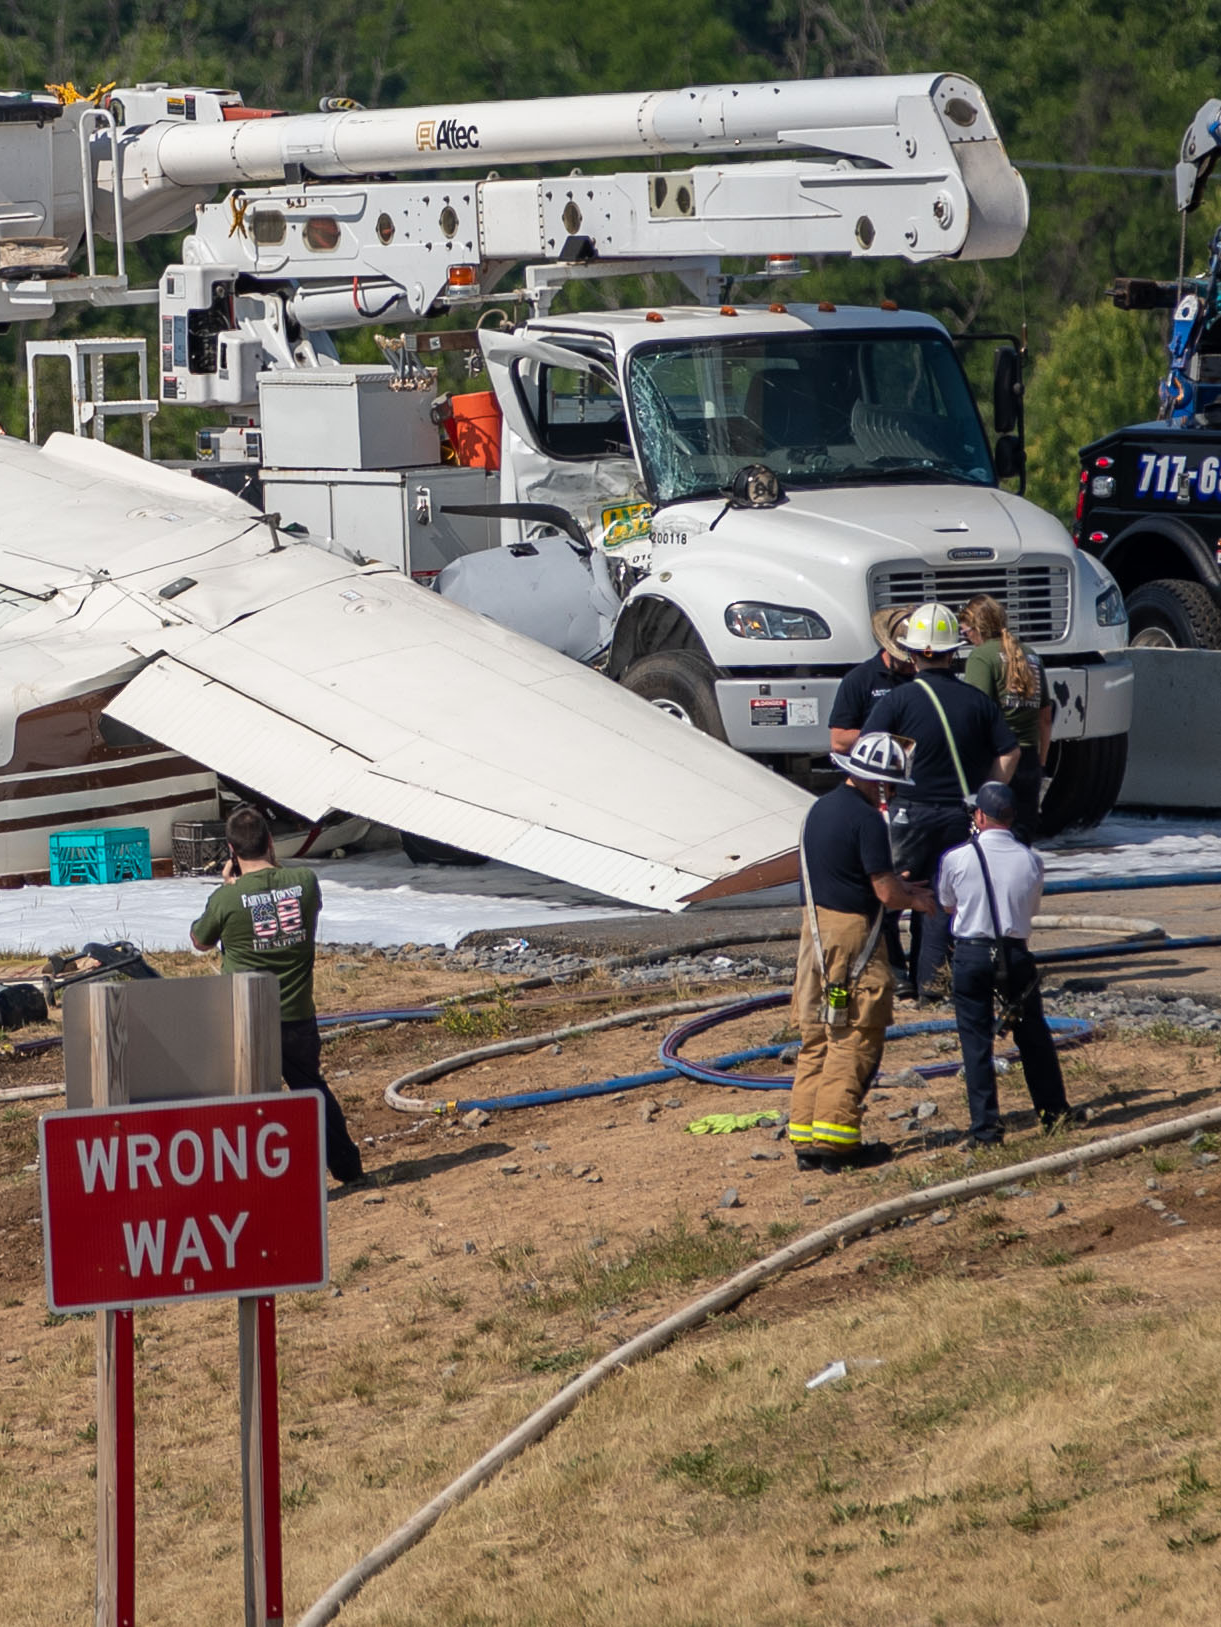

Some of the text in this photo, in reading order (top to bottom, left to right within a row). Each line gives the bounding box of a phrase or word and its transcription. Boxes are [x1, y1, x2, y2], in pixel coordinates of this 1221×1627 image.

[436, 119, 480, 150] Altec
[1138, 454, 1221, 494] 717-6
[251, 898, 303, 938] 68
[76, 1122, 290, 1194] WRONG
[122, 1211, 250, 1278] WAY
